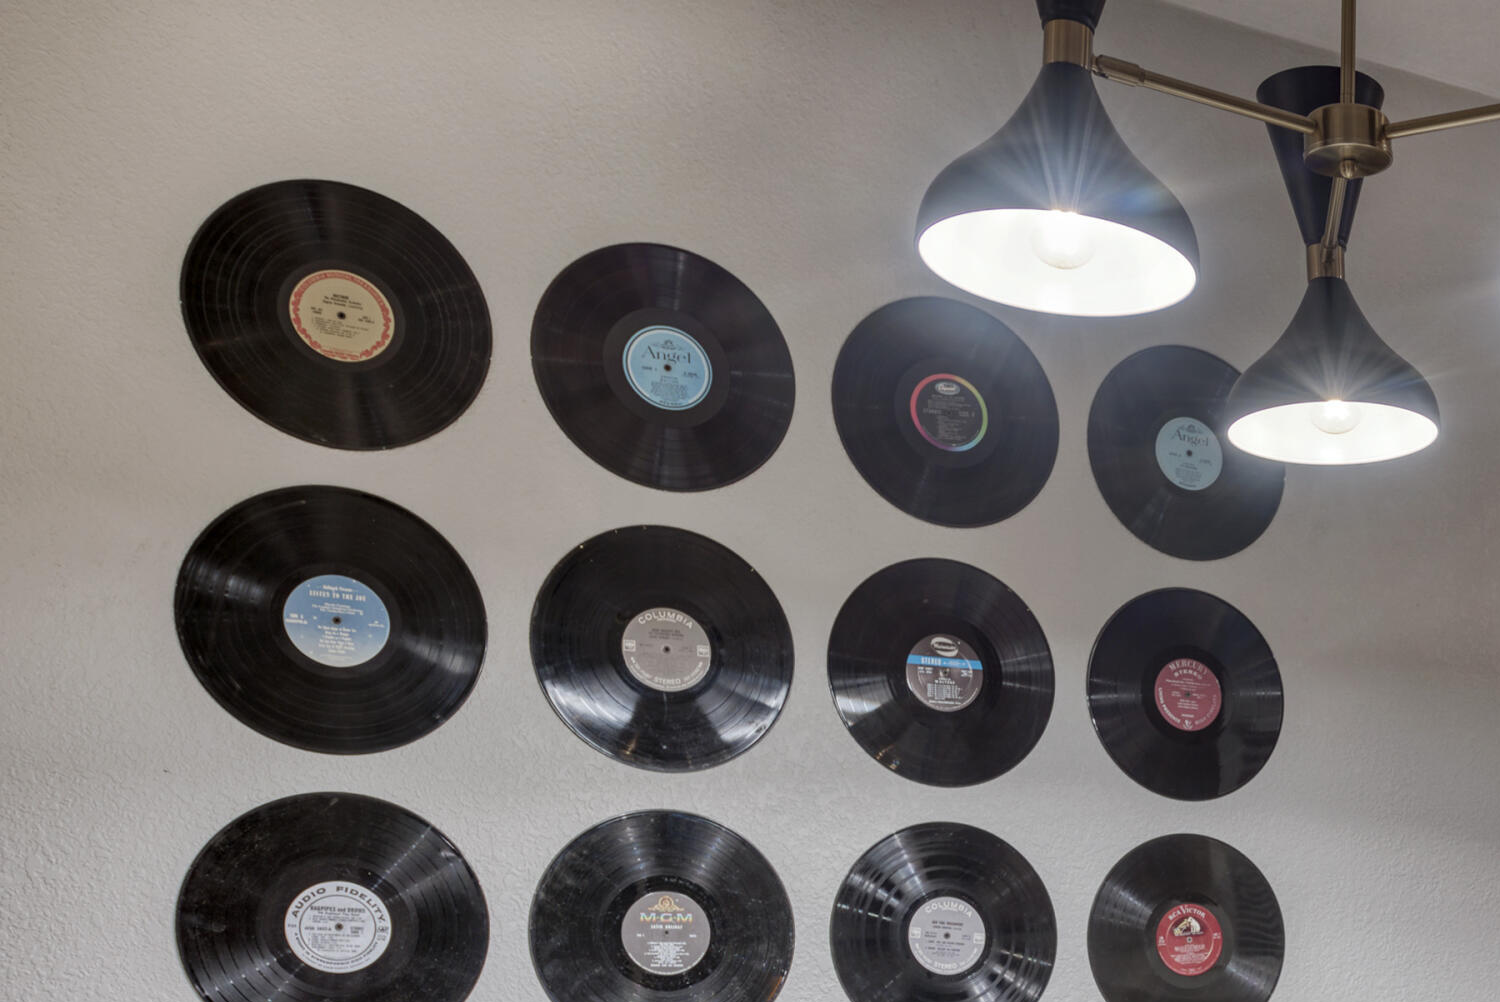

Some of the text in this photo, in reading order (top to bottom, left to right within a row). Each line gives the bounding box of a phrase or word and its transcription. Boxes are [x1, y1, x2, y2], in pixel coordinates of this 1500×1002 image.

[638, 611, 693, 629] COLUMBIA
[292, 886, 387, 922] AUDIO FIDELITY
